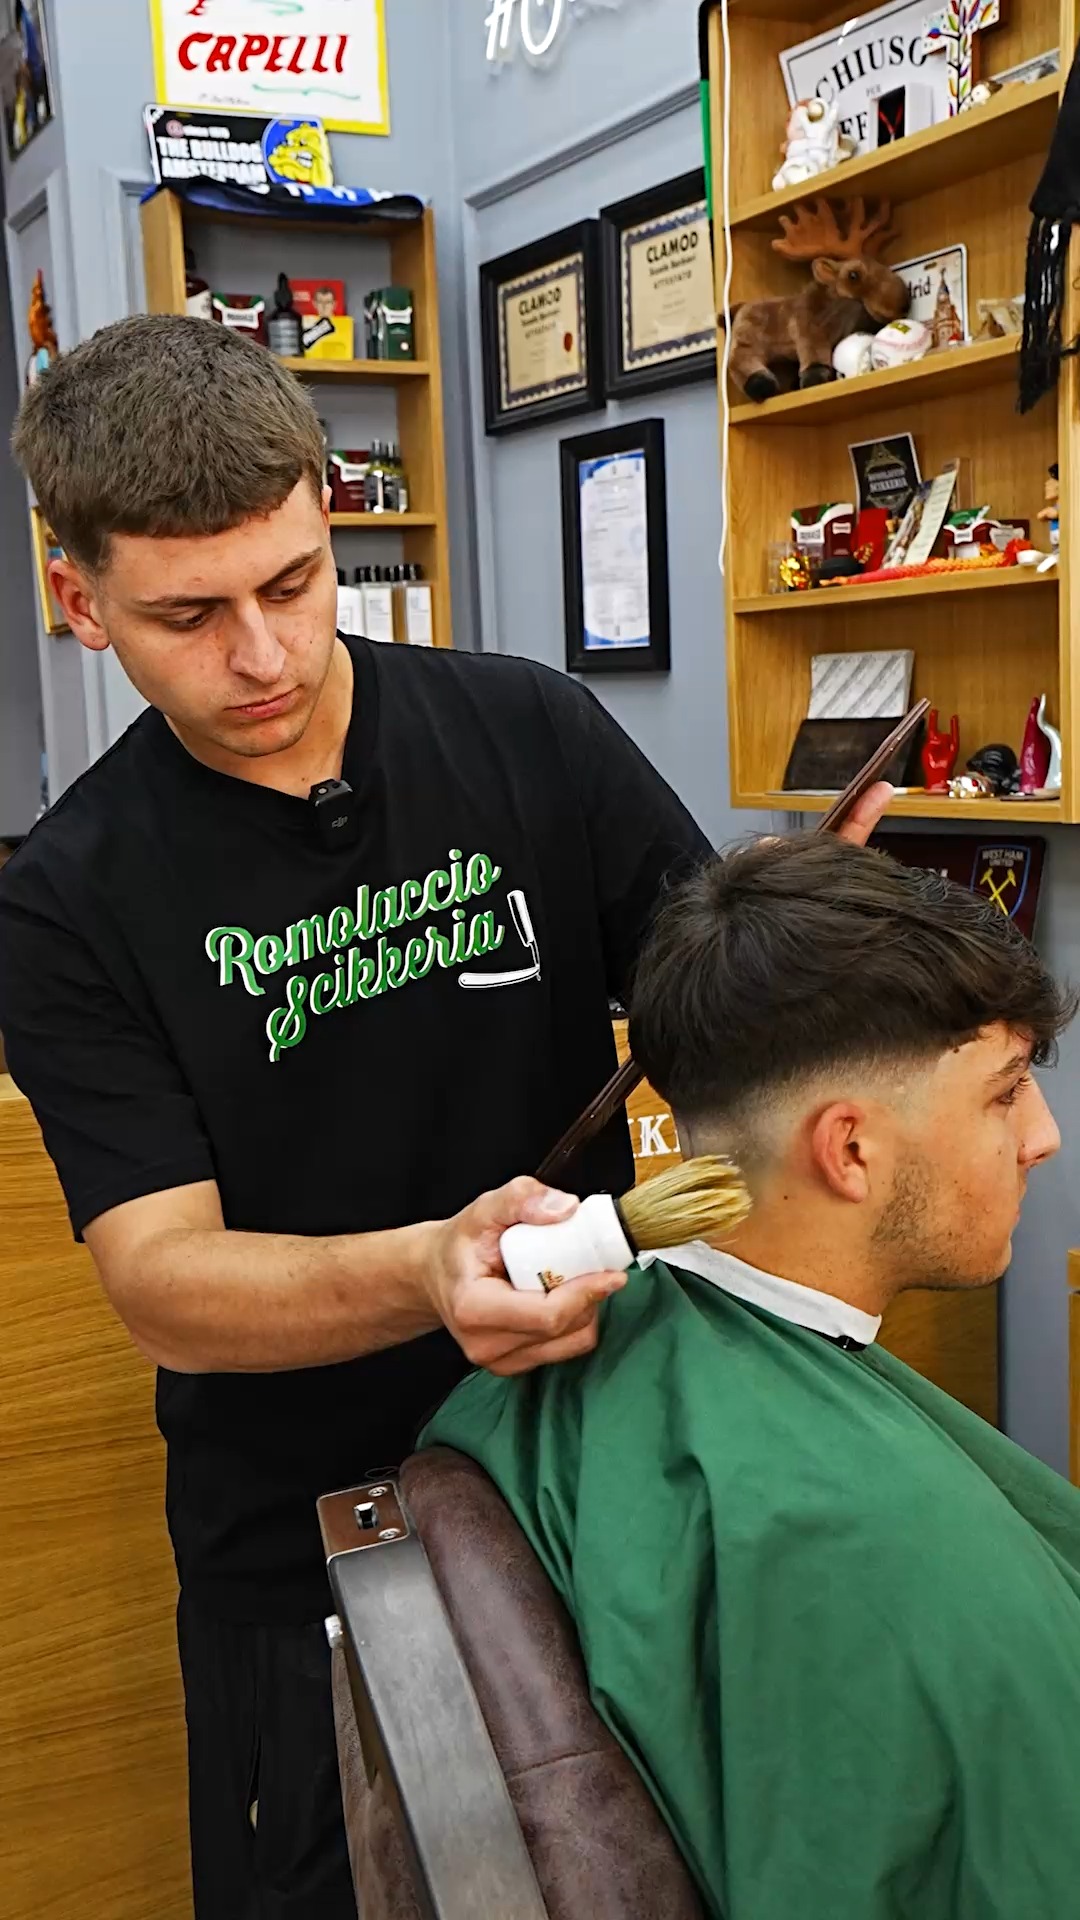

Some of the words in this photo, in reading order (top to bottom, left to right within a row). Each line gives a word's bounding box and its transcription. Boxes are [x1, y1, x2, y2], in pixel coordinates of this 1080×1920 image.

[178, 32, 350, 74] CAPELLI
[646, 231, 698, 263] CLAMOD
[205, 849, 502, 996] Romolaccio
[266, 909, 505, 1063] Scikkeria
